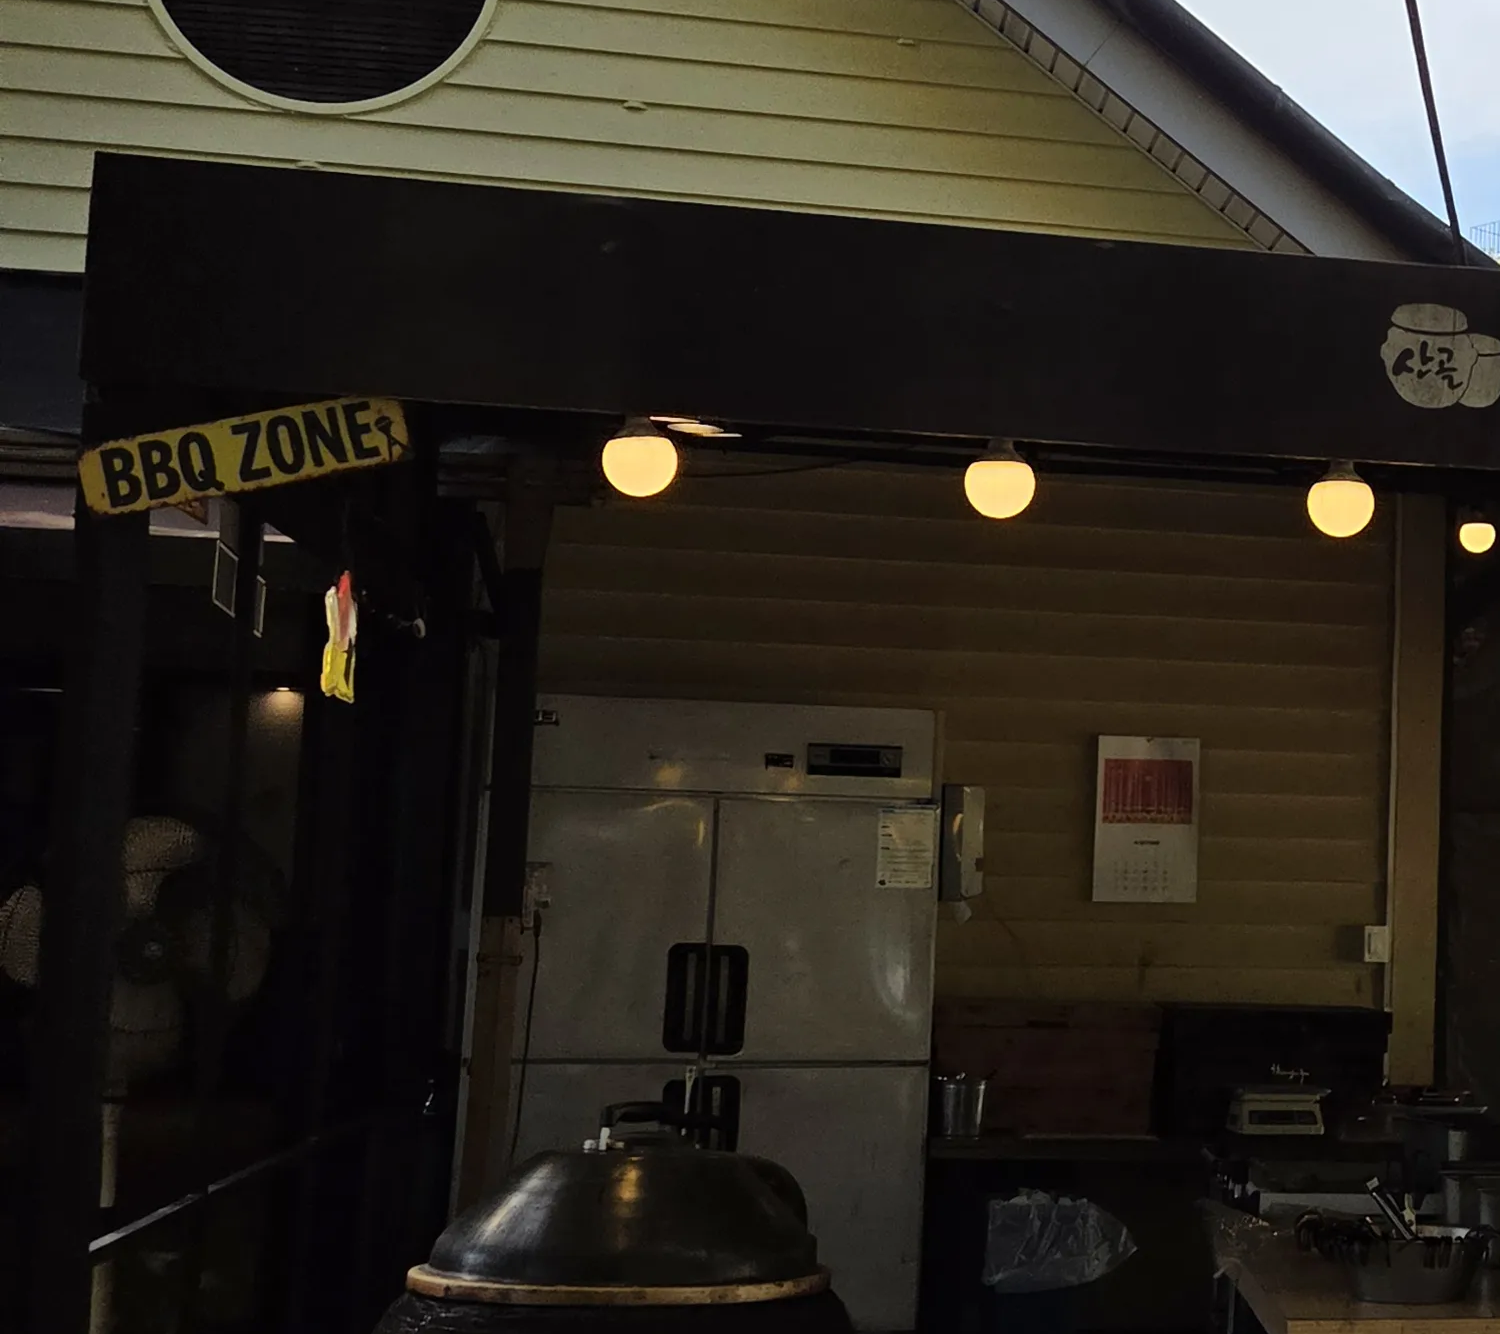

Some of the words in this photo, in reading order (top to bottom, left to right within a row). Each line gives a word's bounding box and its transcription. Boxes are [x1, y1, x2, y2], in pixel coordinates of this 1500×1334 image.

[1392, 340, 1463, 390] 산골
[101, 431, 225, 508] BBQ
[230, 400, 381, 482] ZONE
